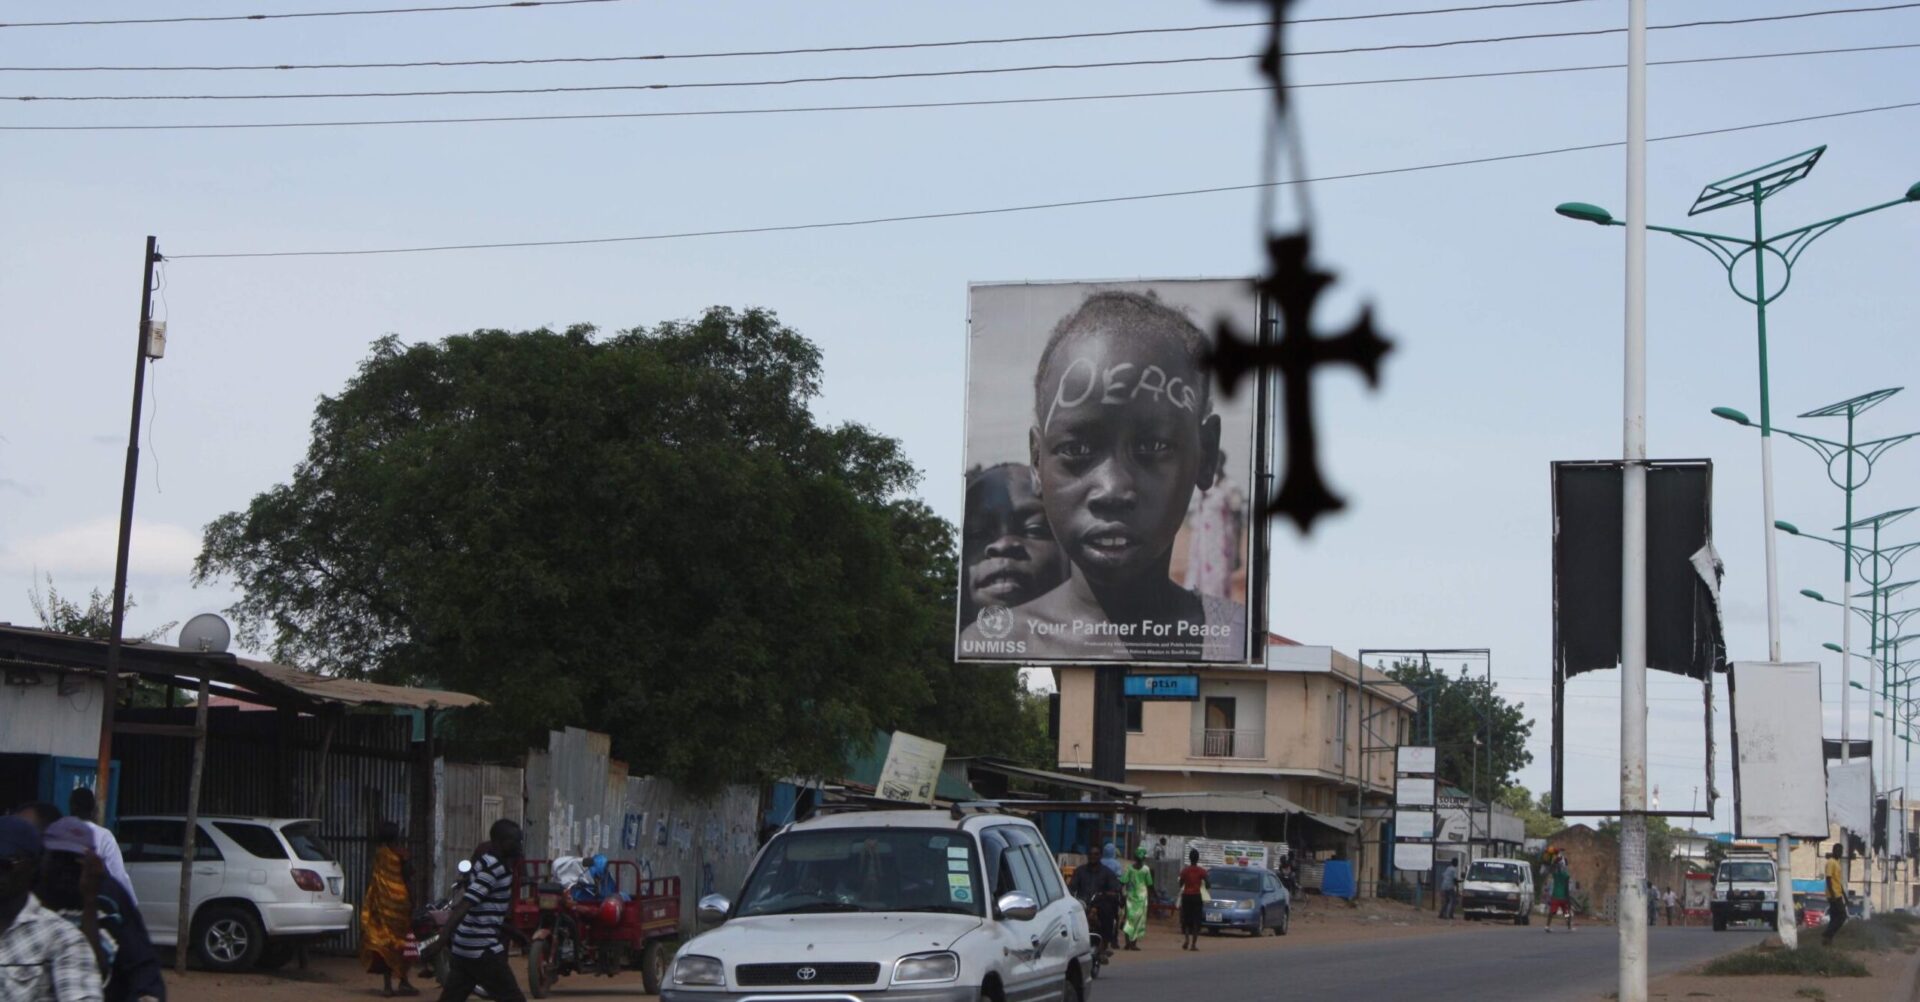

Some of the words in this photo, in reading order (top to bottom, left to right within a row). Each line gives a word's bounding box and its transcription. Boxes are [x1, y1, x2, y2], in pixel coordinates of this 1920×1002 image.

[1027, 620, 1067, 635] Your
[1072, 620, 1137, 636] Partner
[1142, 620, 1172, 636] For
[1177, 620, 1231, 637] Peace
[963, 640, 1026, 653] UNMISS
